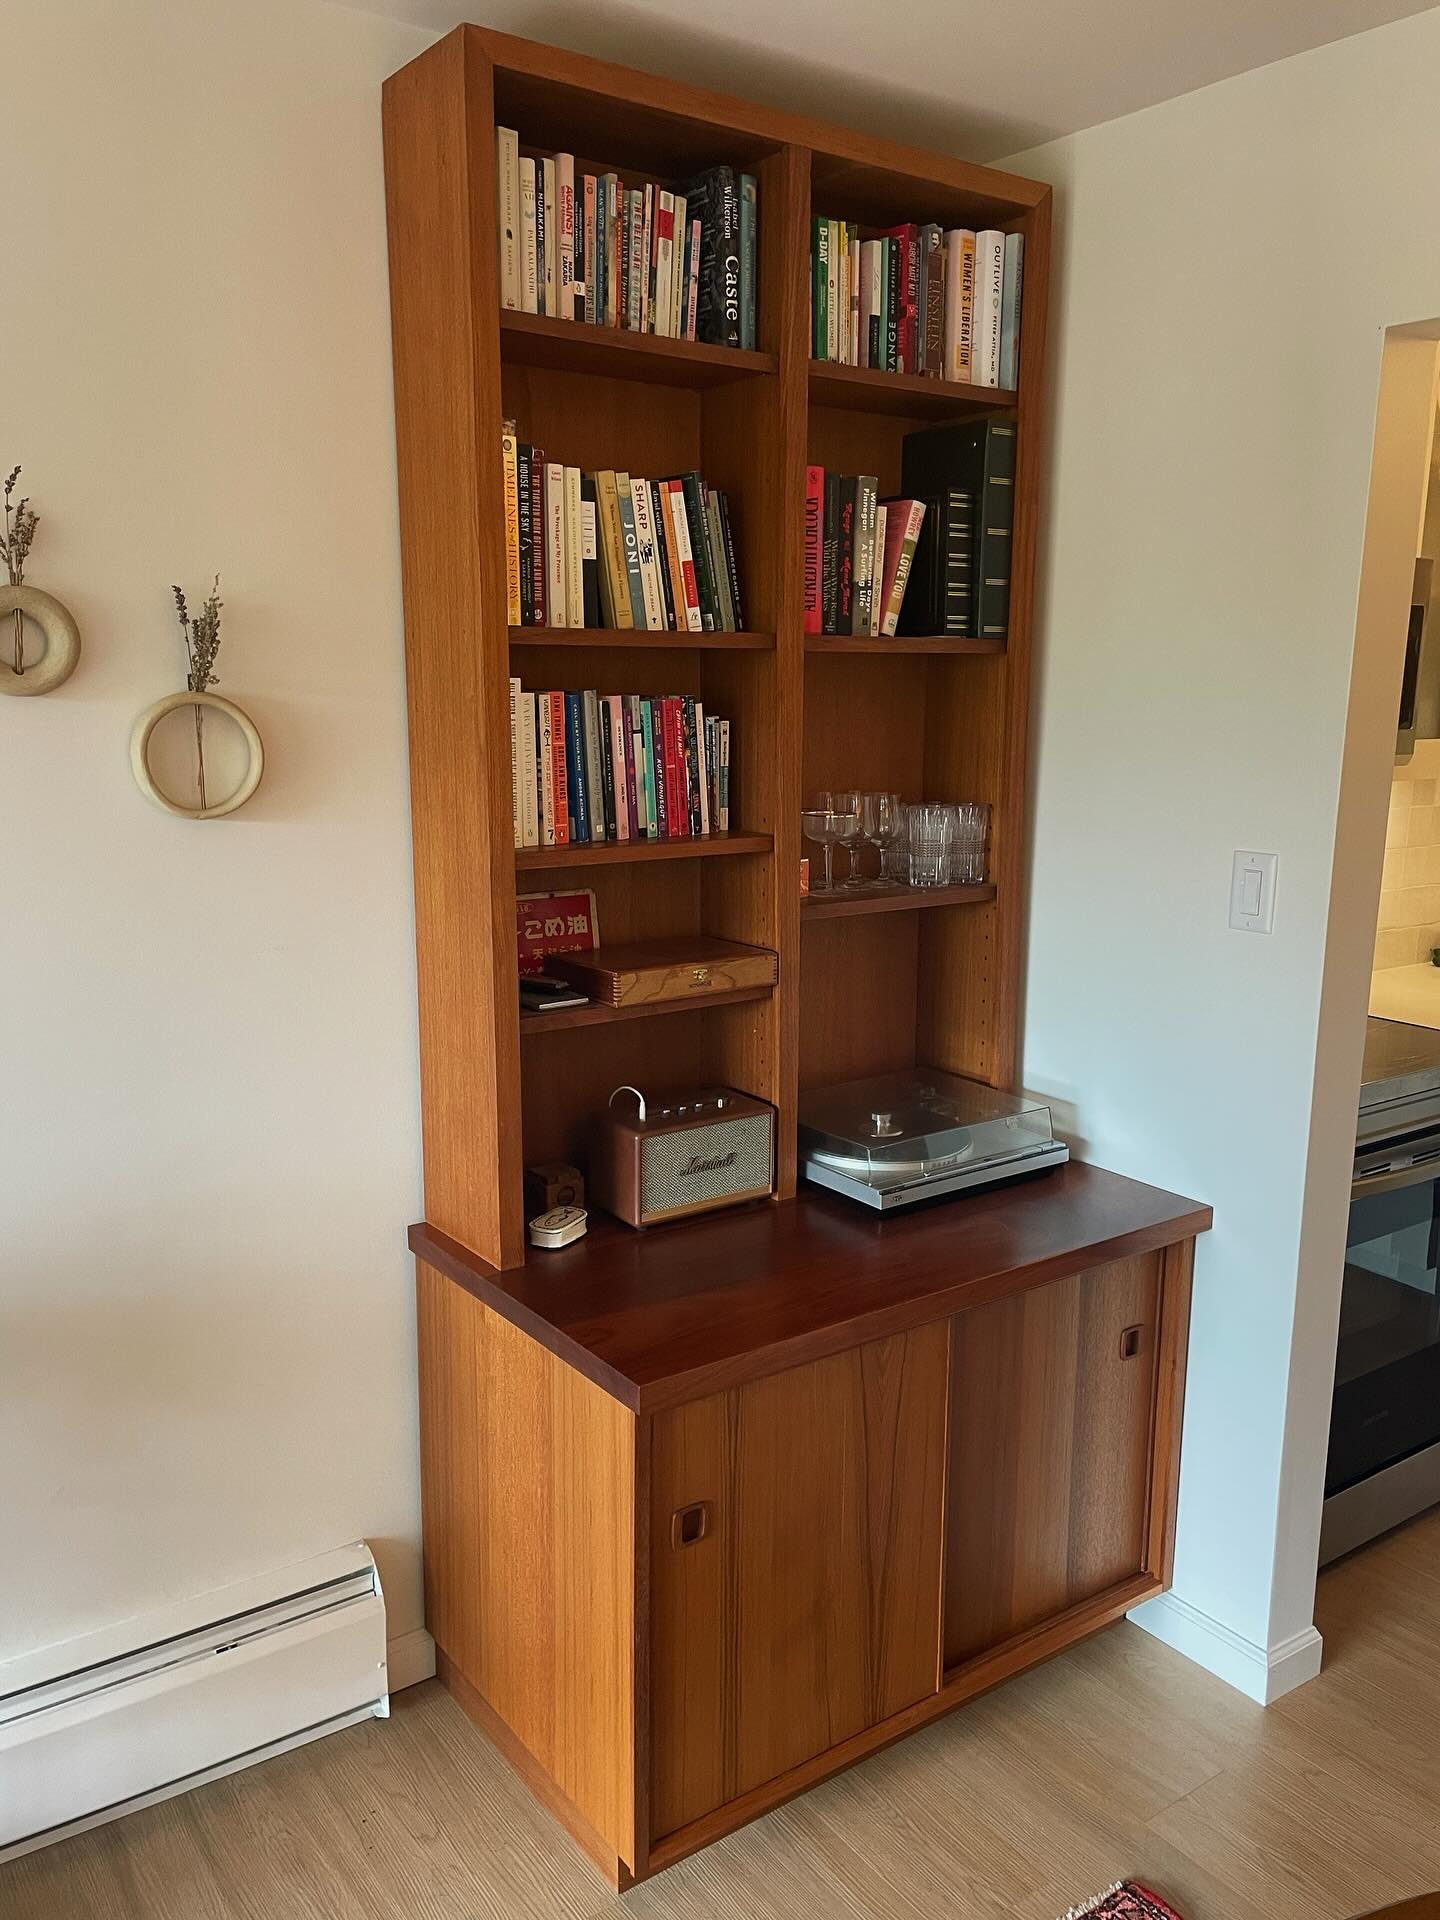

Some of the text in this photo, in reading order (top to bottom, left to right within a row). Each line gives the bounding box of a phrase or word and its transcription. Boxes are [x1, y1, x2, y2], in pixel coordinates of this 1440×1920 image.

[565, 185, 574, 238] AGAINST
[621, 200, 629, 227] MARY
[724, 186, 733, 239] Wilkerson
[527, 229, 535, 249] PAUL
[633, 201, 642, 269] THE BELL JAR
[819, 227, 828, 264] D-DAY
[908, 241, 917, 264] GABOR
[992, 245, 1001, 294] OUTLIVE
[586, 284, 596, 304] SACKS
[725, 255, 740, 321] Caste
[930, 280, 942, 351] EINSTEIN
[960, 253, 973, 366] WOMEN'S LIBERATION
[888, 321, 898, 373] RANGE
[520, 464, 529, 488] HOUSE
[532, 475, 540, 487] THE
[521, 491, 529, 499] IN
[521, 502, 530, 514] THE
[635, 485, 648, 530] SHARP
[652, 490, 661, 510] david
[860, 487, 871, 532] Finnegan
[869, 491, 877, 529] William
[506, 459, 518, 601] TIMELINES HISTORY
[521, 517, 530, 531] SKY
[907, 506, 921, 537] HOWREY
[623, 521, 640, 575] JONI
[728, 541, 737, 574] HUNGER
[823, 539, 832, 564] With
[831, 540, 839, 575] Women
[732, 575, 740, 601] GAMES
[823, 564, 831, 579] the
[858, 543, 870, 607] A Surfing Life
[892, 553, 911, 599] LOVE YOU
[823, 579, 831, 612] Wolves
[865, 589, 873, 613] Days
[523, 699, 531, 728] MARY
[656, 758, 664, 779] KURT
[526, 779, 534, 825] Devotions
[516, 914, 589, 940] こめ油
[679, 1152, 738, 1177] Marshall
